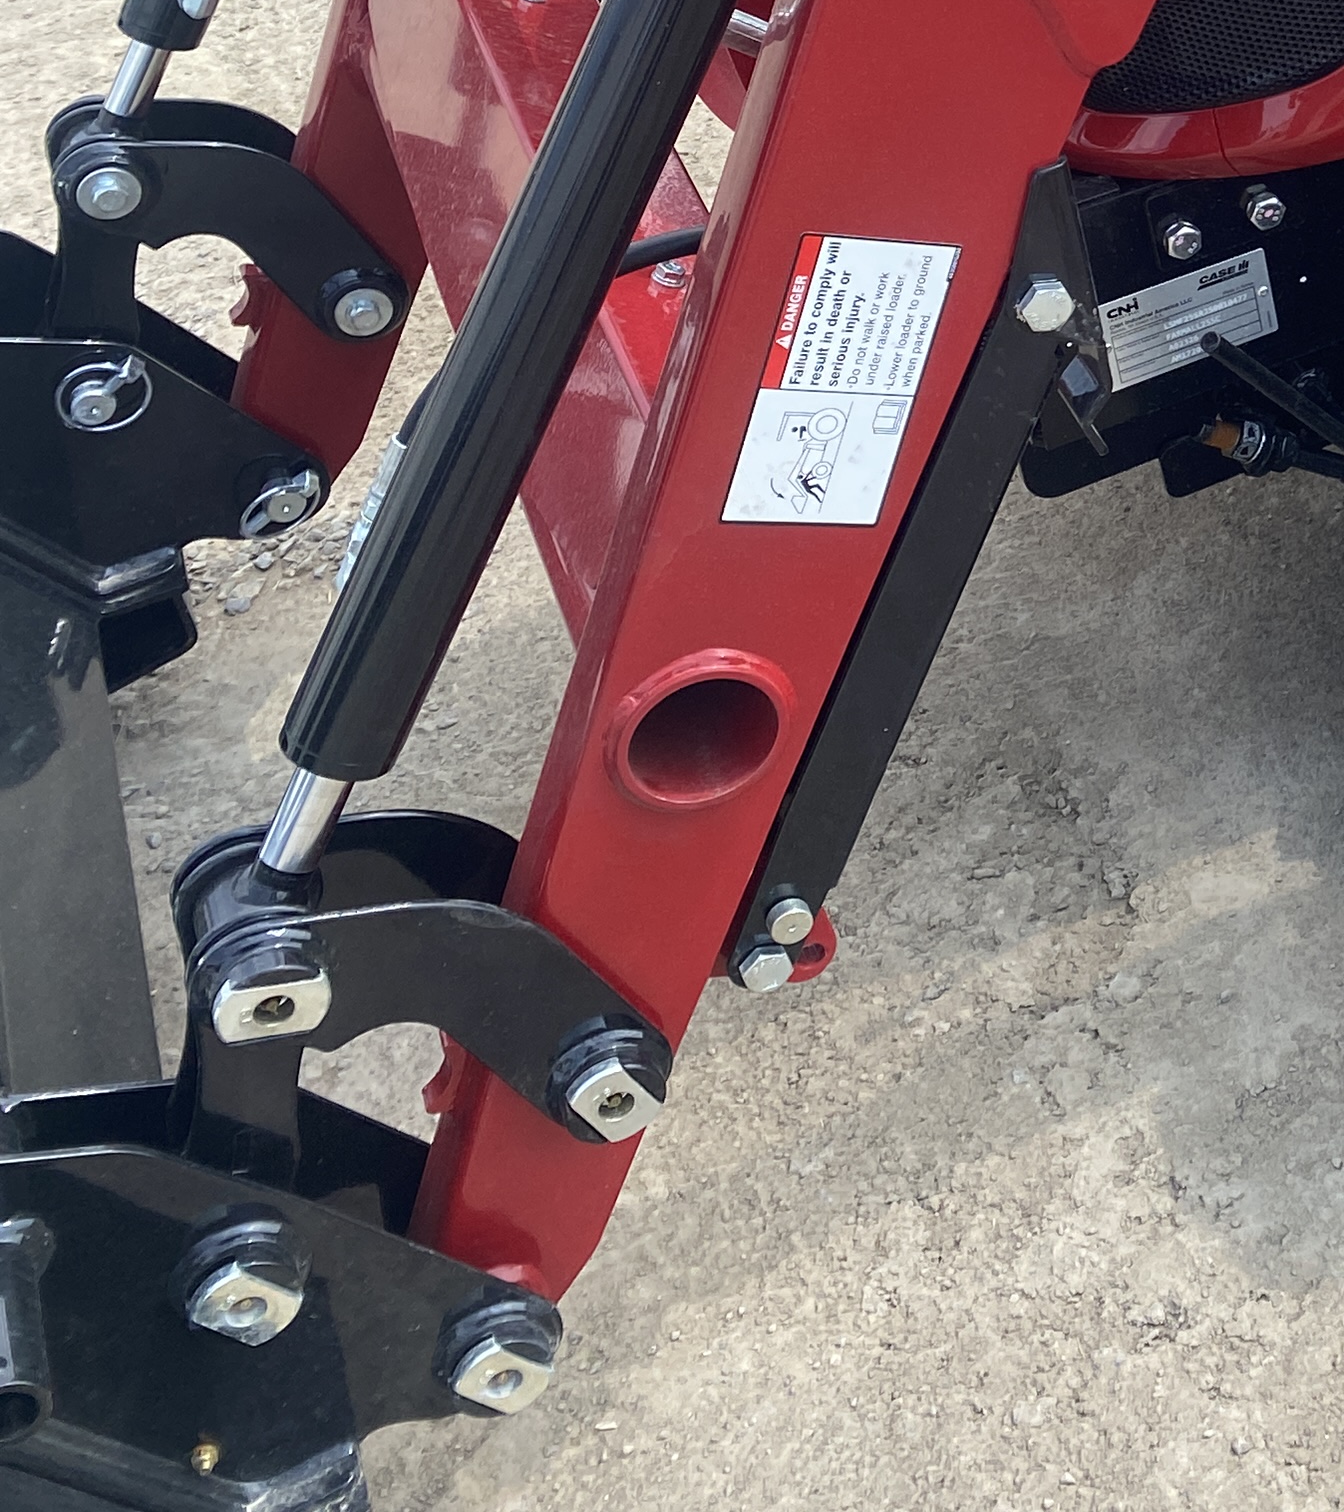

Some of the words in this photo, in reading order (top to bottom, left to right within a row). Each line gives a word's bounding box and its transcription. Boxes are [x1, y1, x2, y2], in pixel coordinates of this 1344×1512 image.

[840, 270, 852, 285] or
[874, 272, 891, 301] work
[1199, 265, 1236, 285] CASE
[780, 274, 809, 332] DANGER
[826, 289, 847, 327] death
[870, 302, 880, 315] or
[885, 273, 907, 312] loader.
[789, 339, 813, 385] Failure
[804, 321, 818, 336] to
[812, 268, 837, 318] comply
[826, 241, 842, 265] will
[887, 351, 903, 387] Lower
[895, 312, 915, 350] loader
[907, 299, 920, 311] to
[914, 254, 933, 297] ground
[820, 330, 834, 344] in
[828, 337, 851, 387] serious
[841, 292, 867, 333] injury.
[861, 317, 877, 344] walk
[878, 314, 894, 350] raised
[810, 348, 830, 386] result
[855, 346, 868, 365] not
[902, 356, 919, 388] when
[912, 312, 932, 355] parked.
[847, 368, 861, 385] Do
[865, 353, 883, 386] under
